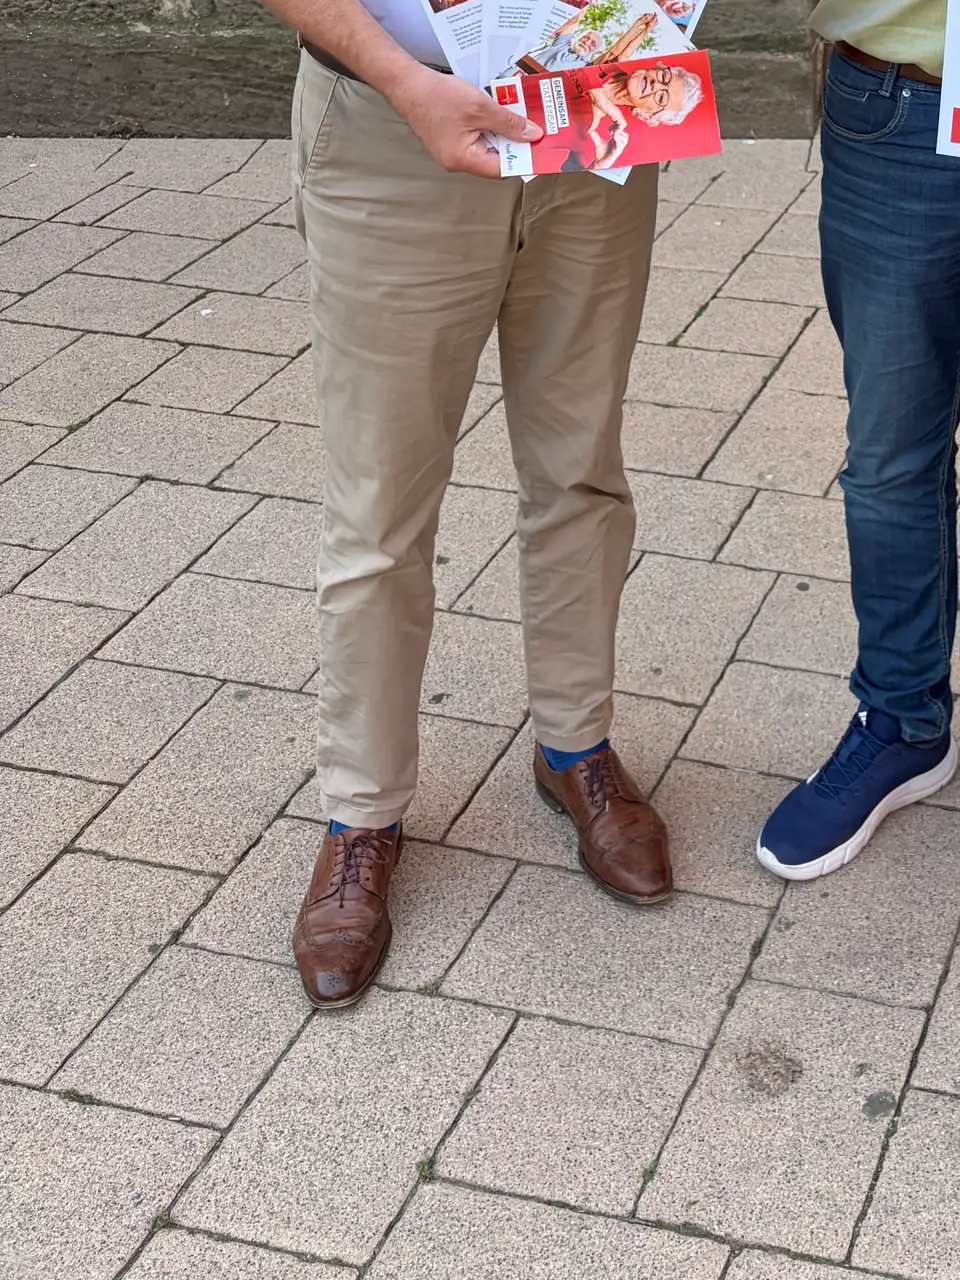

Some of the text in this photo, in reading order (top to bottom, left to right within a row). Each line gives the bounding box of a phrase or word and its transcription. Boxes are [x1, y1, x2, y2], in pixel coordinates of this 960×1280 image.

[542, 82, 556, 133] STATT EINSAM
[554, 80, 566, 125] GEMEINSAM
